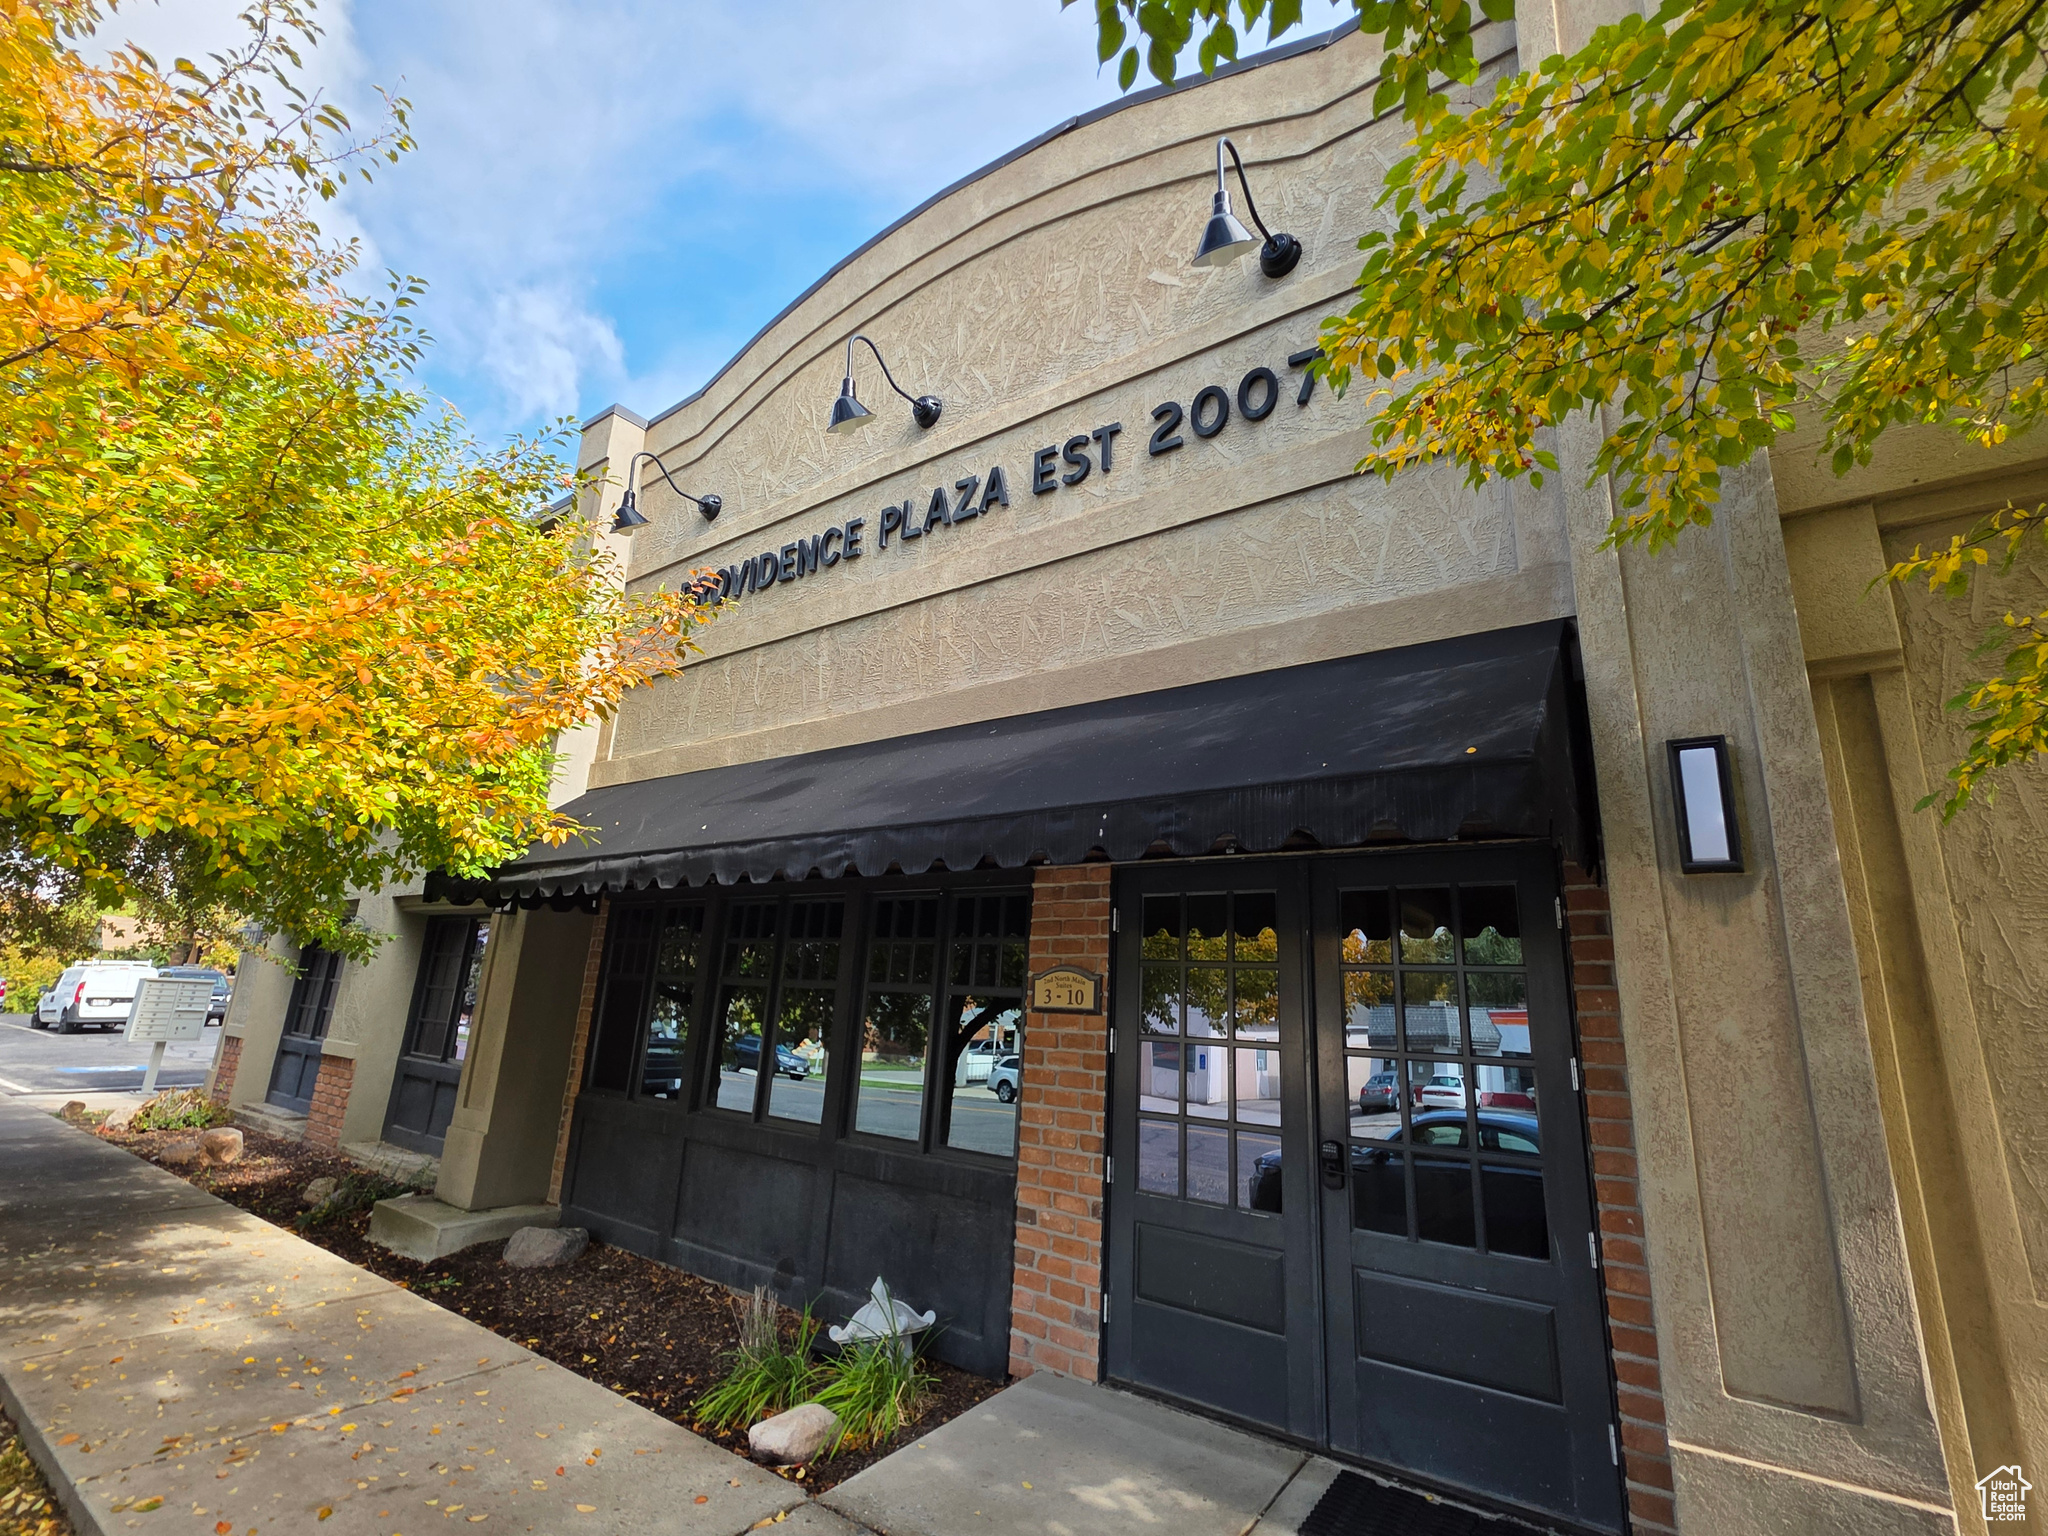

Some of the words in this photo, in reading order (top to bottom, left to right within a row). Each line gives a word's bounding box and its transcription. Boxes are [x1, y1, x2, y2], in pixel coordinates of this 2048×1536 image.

[878, 465, 1009, 550] PLAZA
[1032, 422, 1121, 495] EST
[1149, 346, 1326, 456] 2007
[1071, 976, 1086, 986] Main
[1043, 988, 1052, 1005] 3
[1066, 989, 1084, 1005] 10
